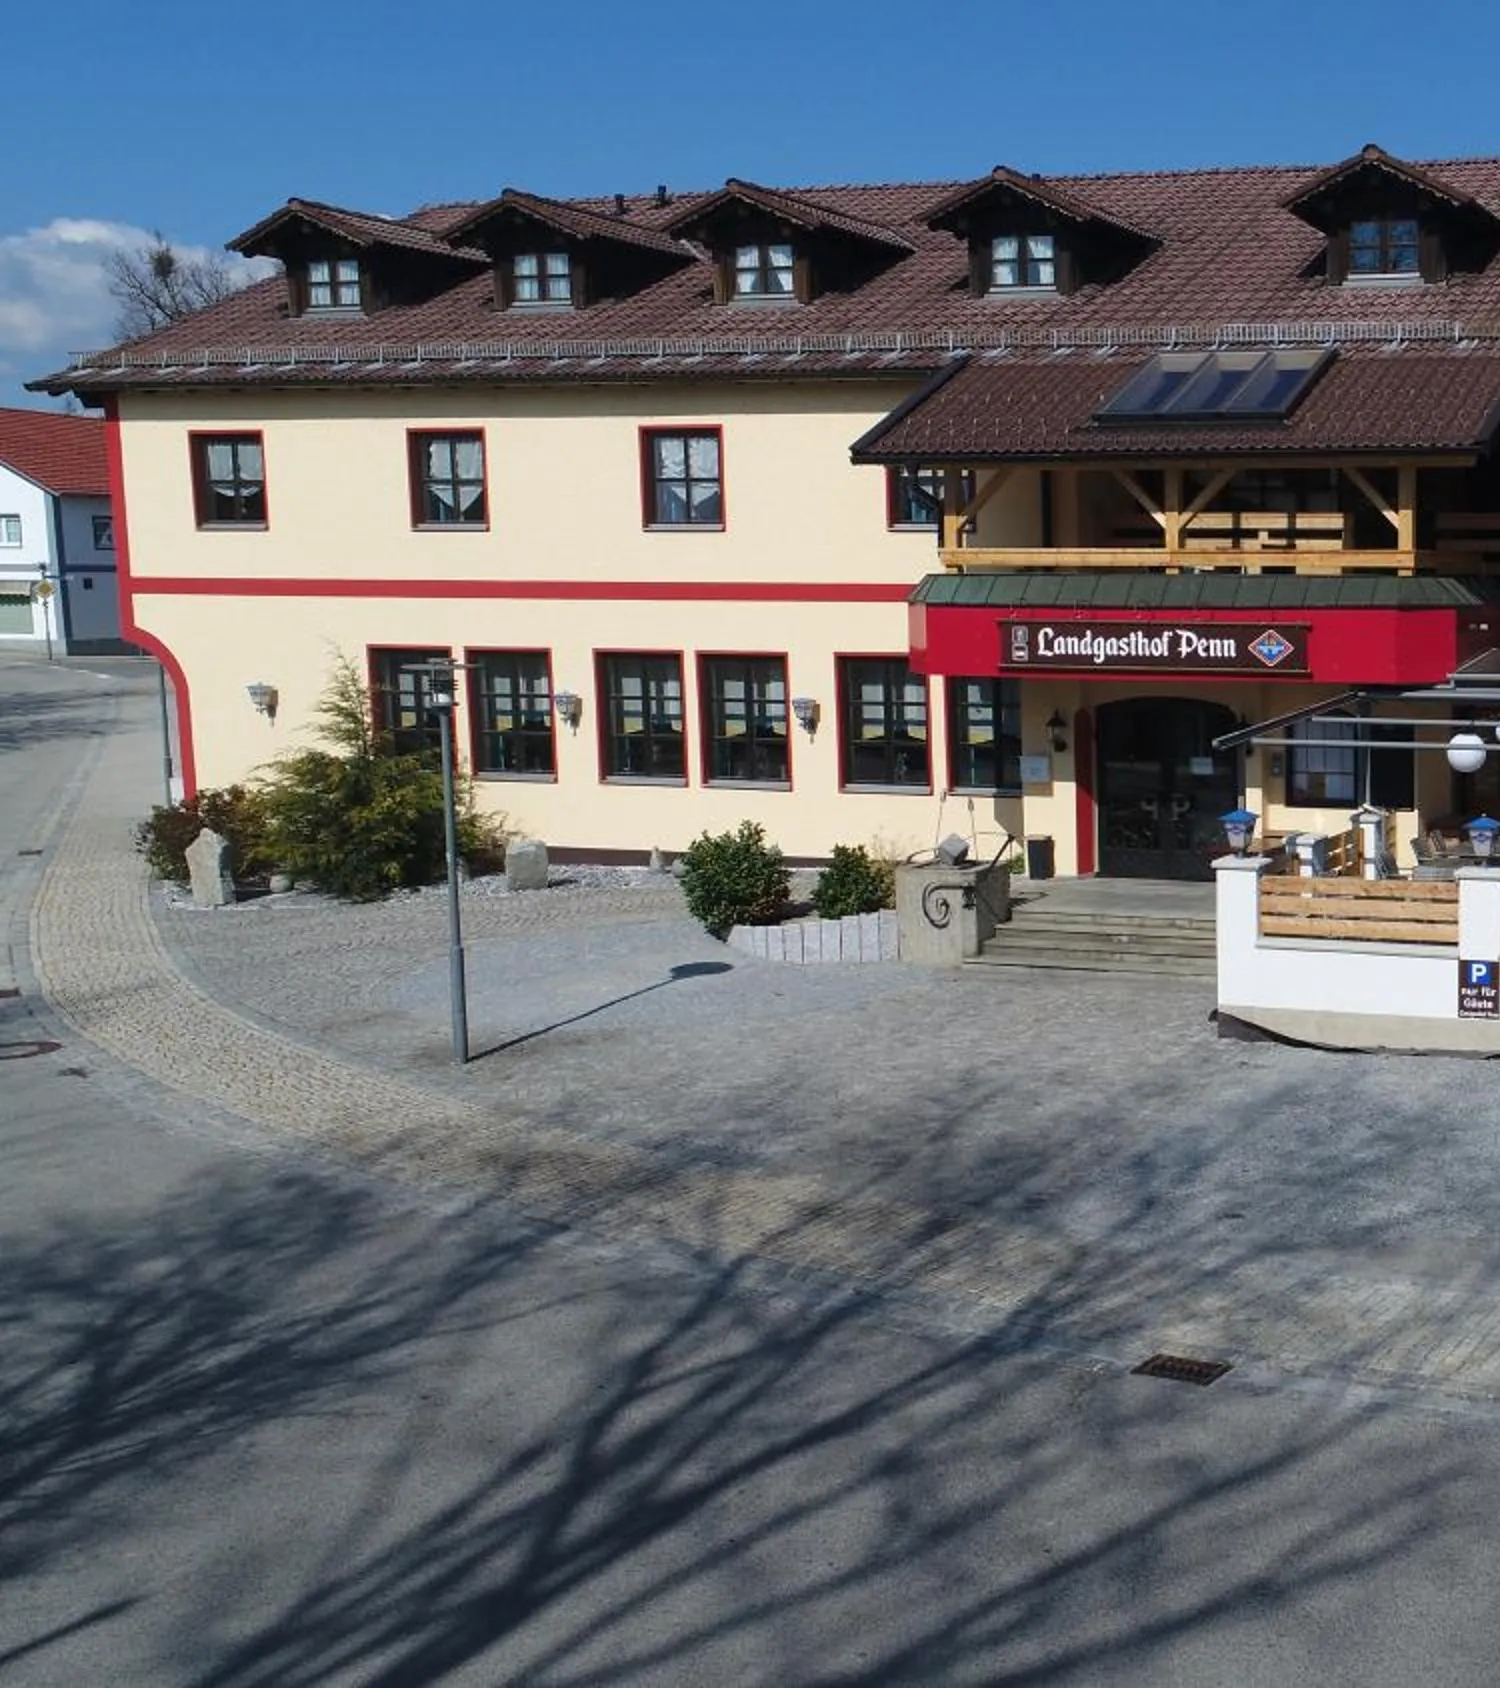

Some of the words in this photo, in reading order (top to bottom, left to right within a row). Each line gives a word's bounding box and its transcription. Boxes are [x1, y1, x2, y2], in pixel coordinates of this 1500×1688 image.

[1037, 627, 1173, 664] Landgasthof
[1175, 629, 1237, 658] Penn
[1471, 963, 1487, 983] P
